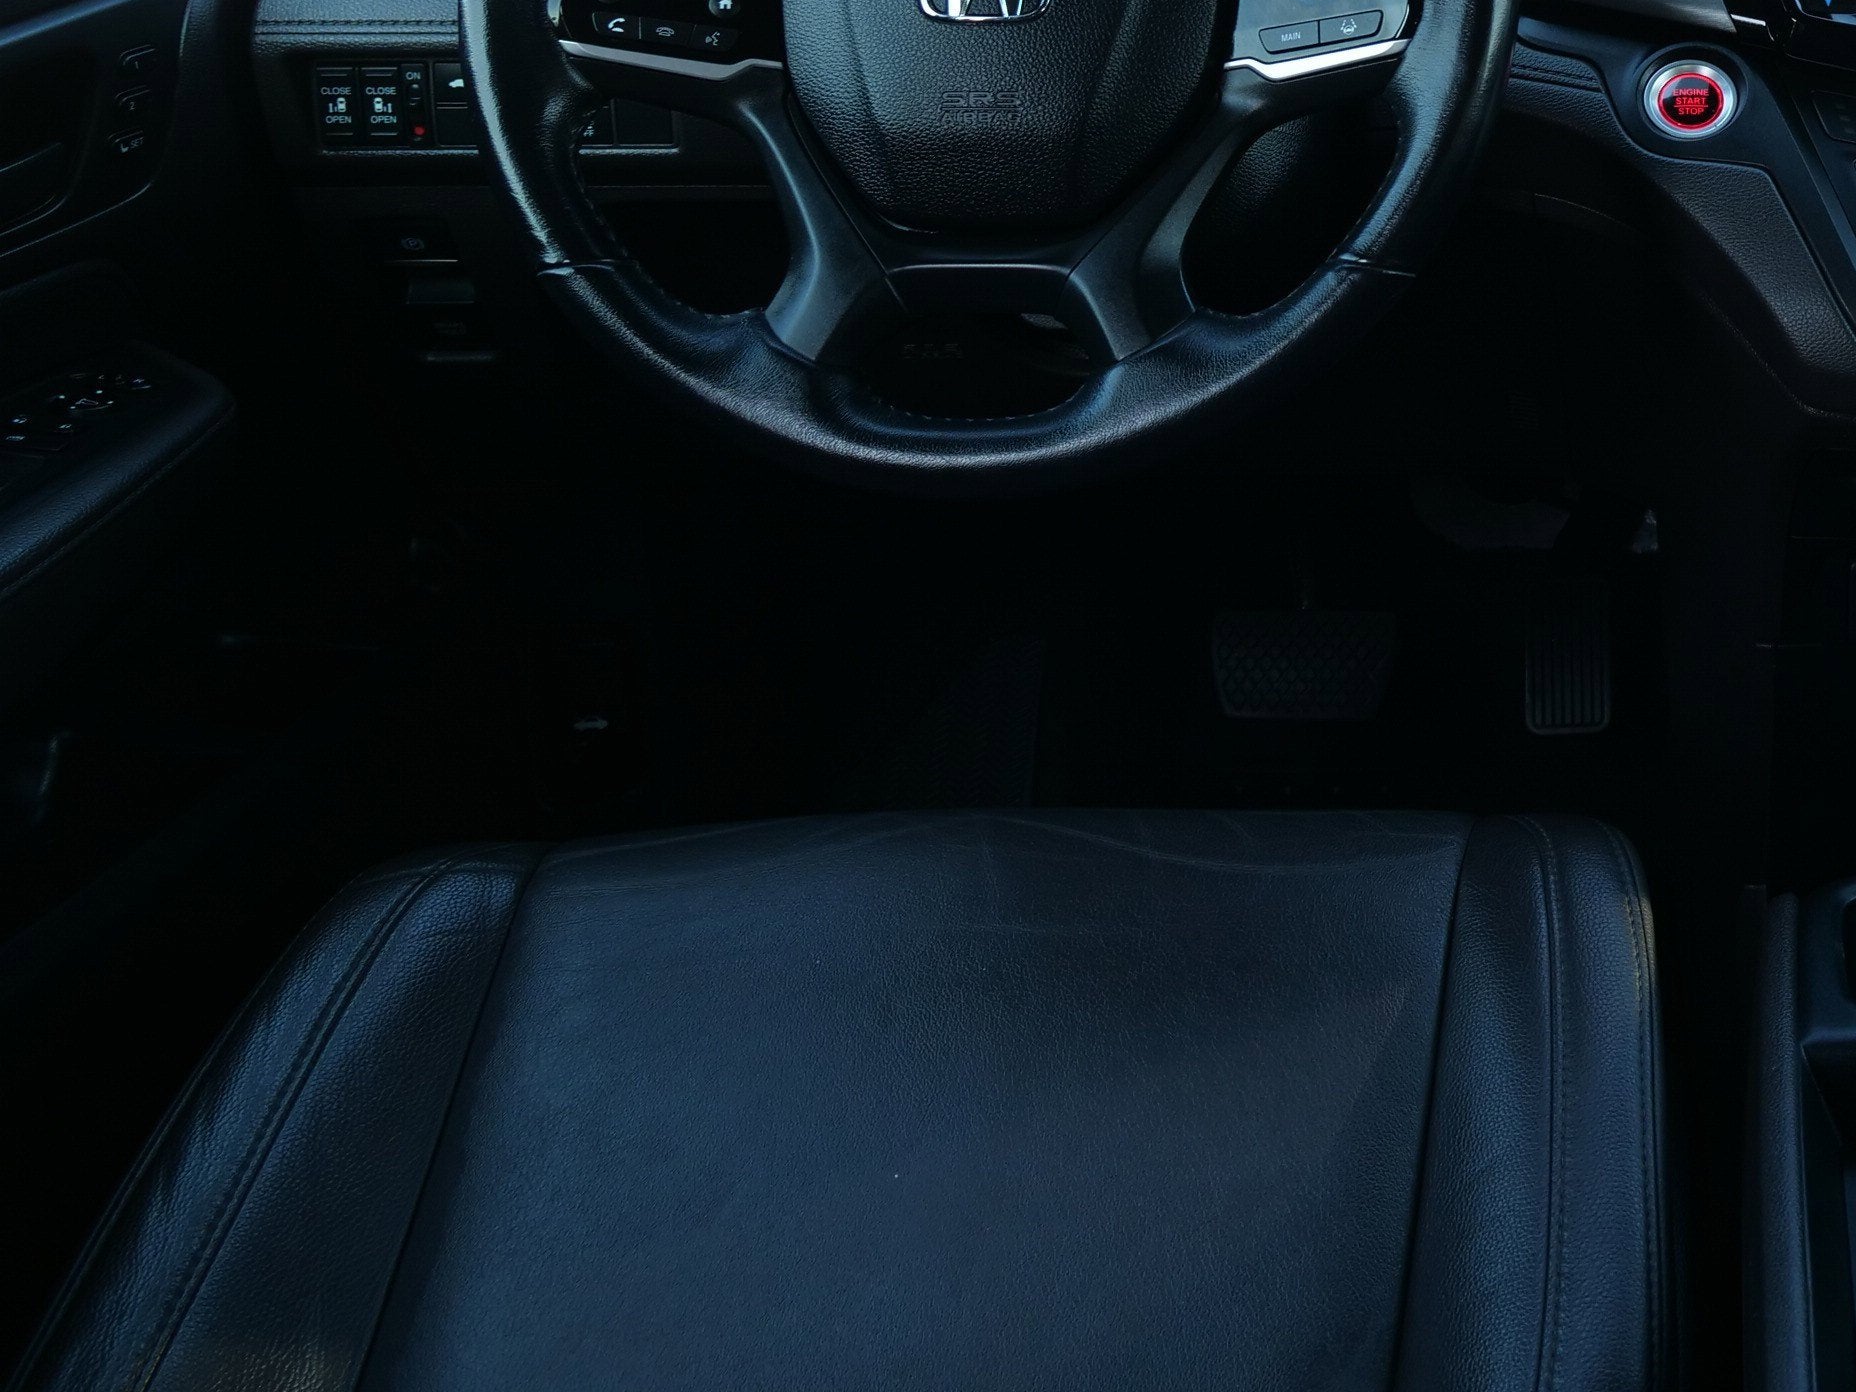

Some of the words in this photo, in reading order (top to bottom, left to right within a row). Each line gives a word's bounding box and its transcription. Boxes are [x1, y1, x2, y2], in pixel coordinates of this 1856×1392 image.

[1280, 32, 1301, 42] MAIN
[405, 71, 421, 80] ON
[320, 86, 352, 95] CLOSE
[366, 86, 397, 95] CLOSE
[1672, 88, 1710, 96] ENGINE
[942, 90, 1022, 106] SRS
[1676, 97, 1706, 105] START
[326, 116, 352, 124] OPEN
[370, 116, 397, 124] OPEN
